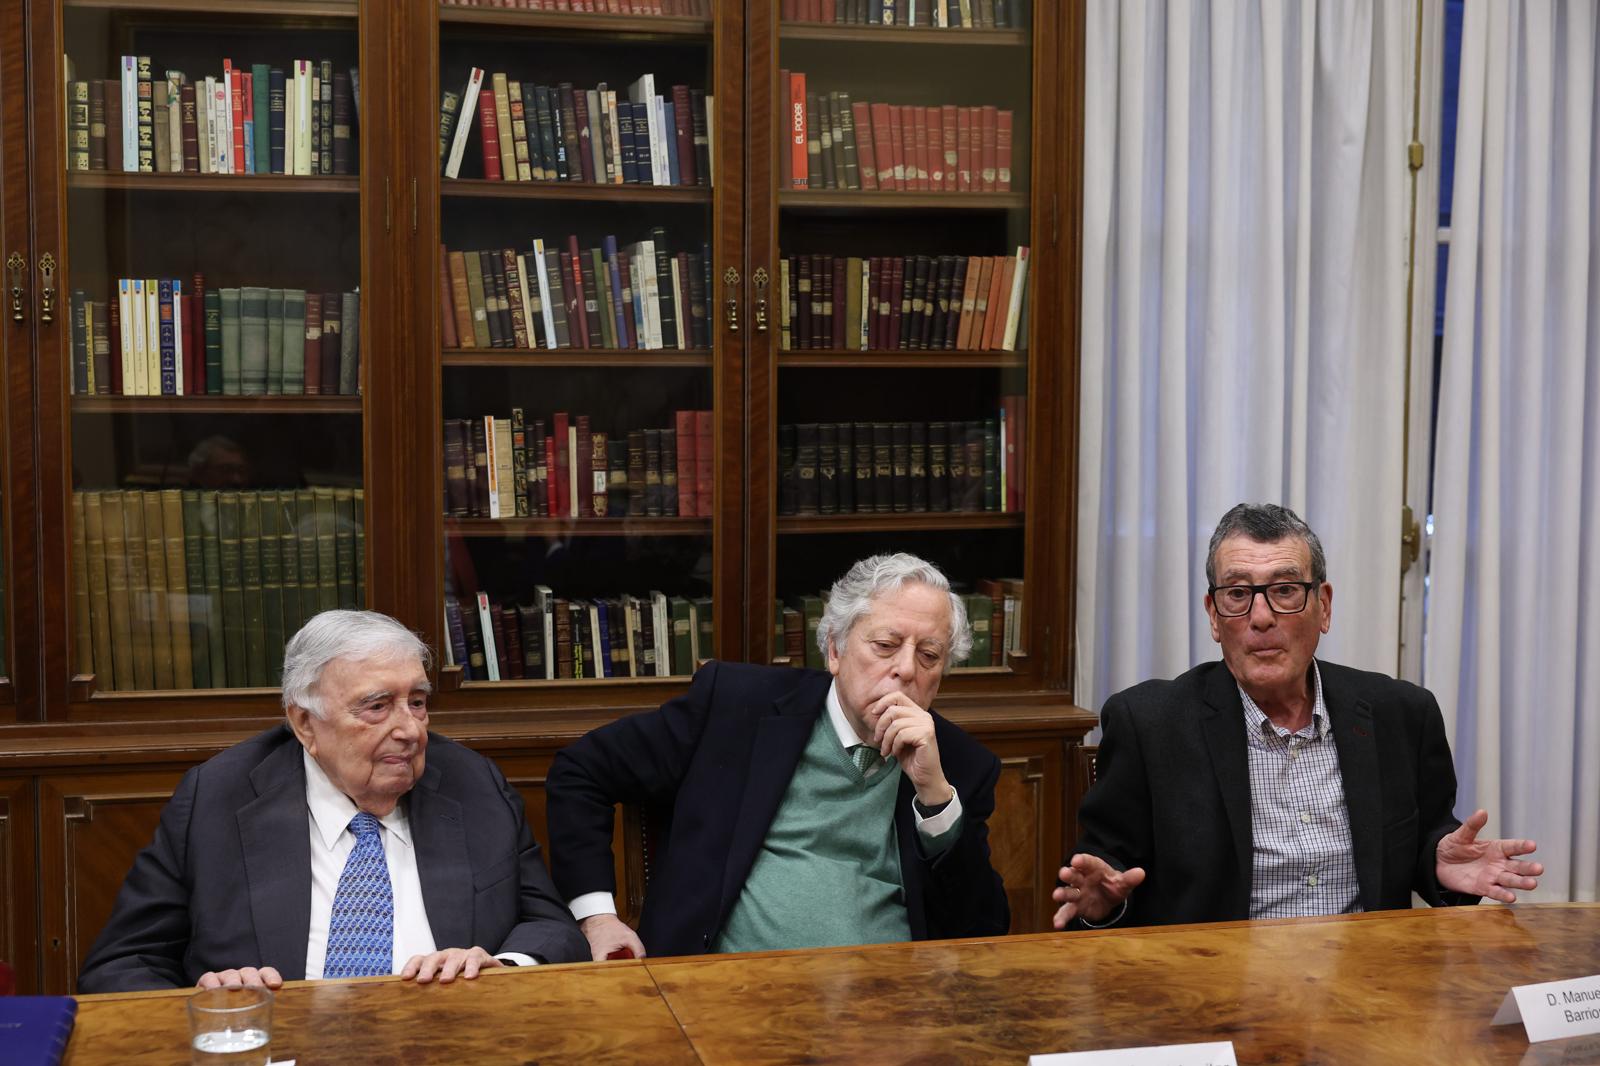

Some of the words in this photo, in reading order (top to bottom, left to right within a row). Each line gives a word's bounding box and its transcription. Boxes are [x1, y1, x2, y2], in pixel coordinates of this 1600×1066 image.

[794, 103, 804, 132] PODER
[795, 134, 804, 145] EL
[1546, 993, 1560, 1006] D.
[1564, 1007, 1600, 1023] Barrio
